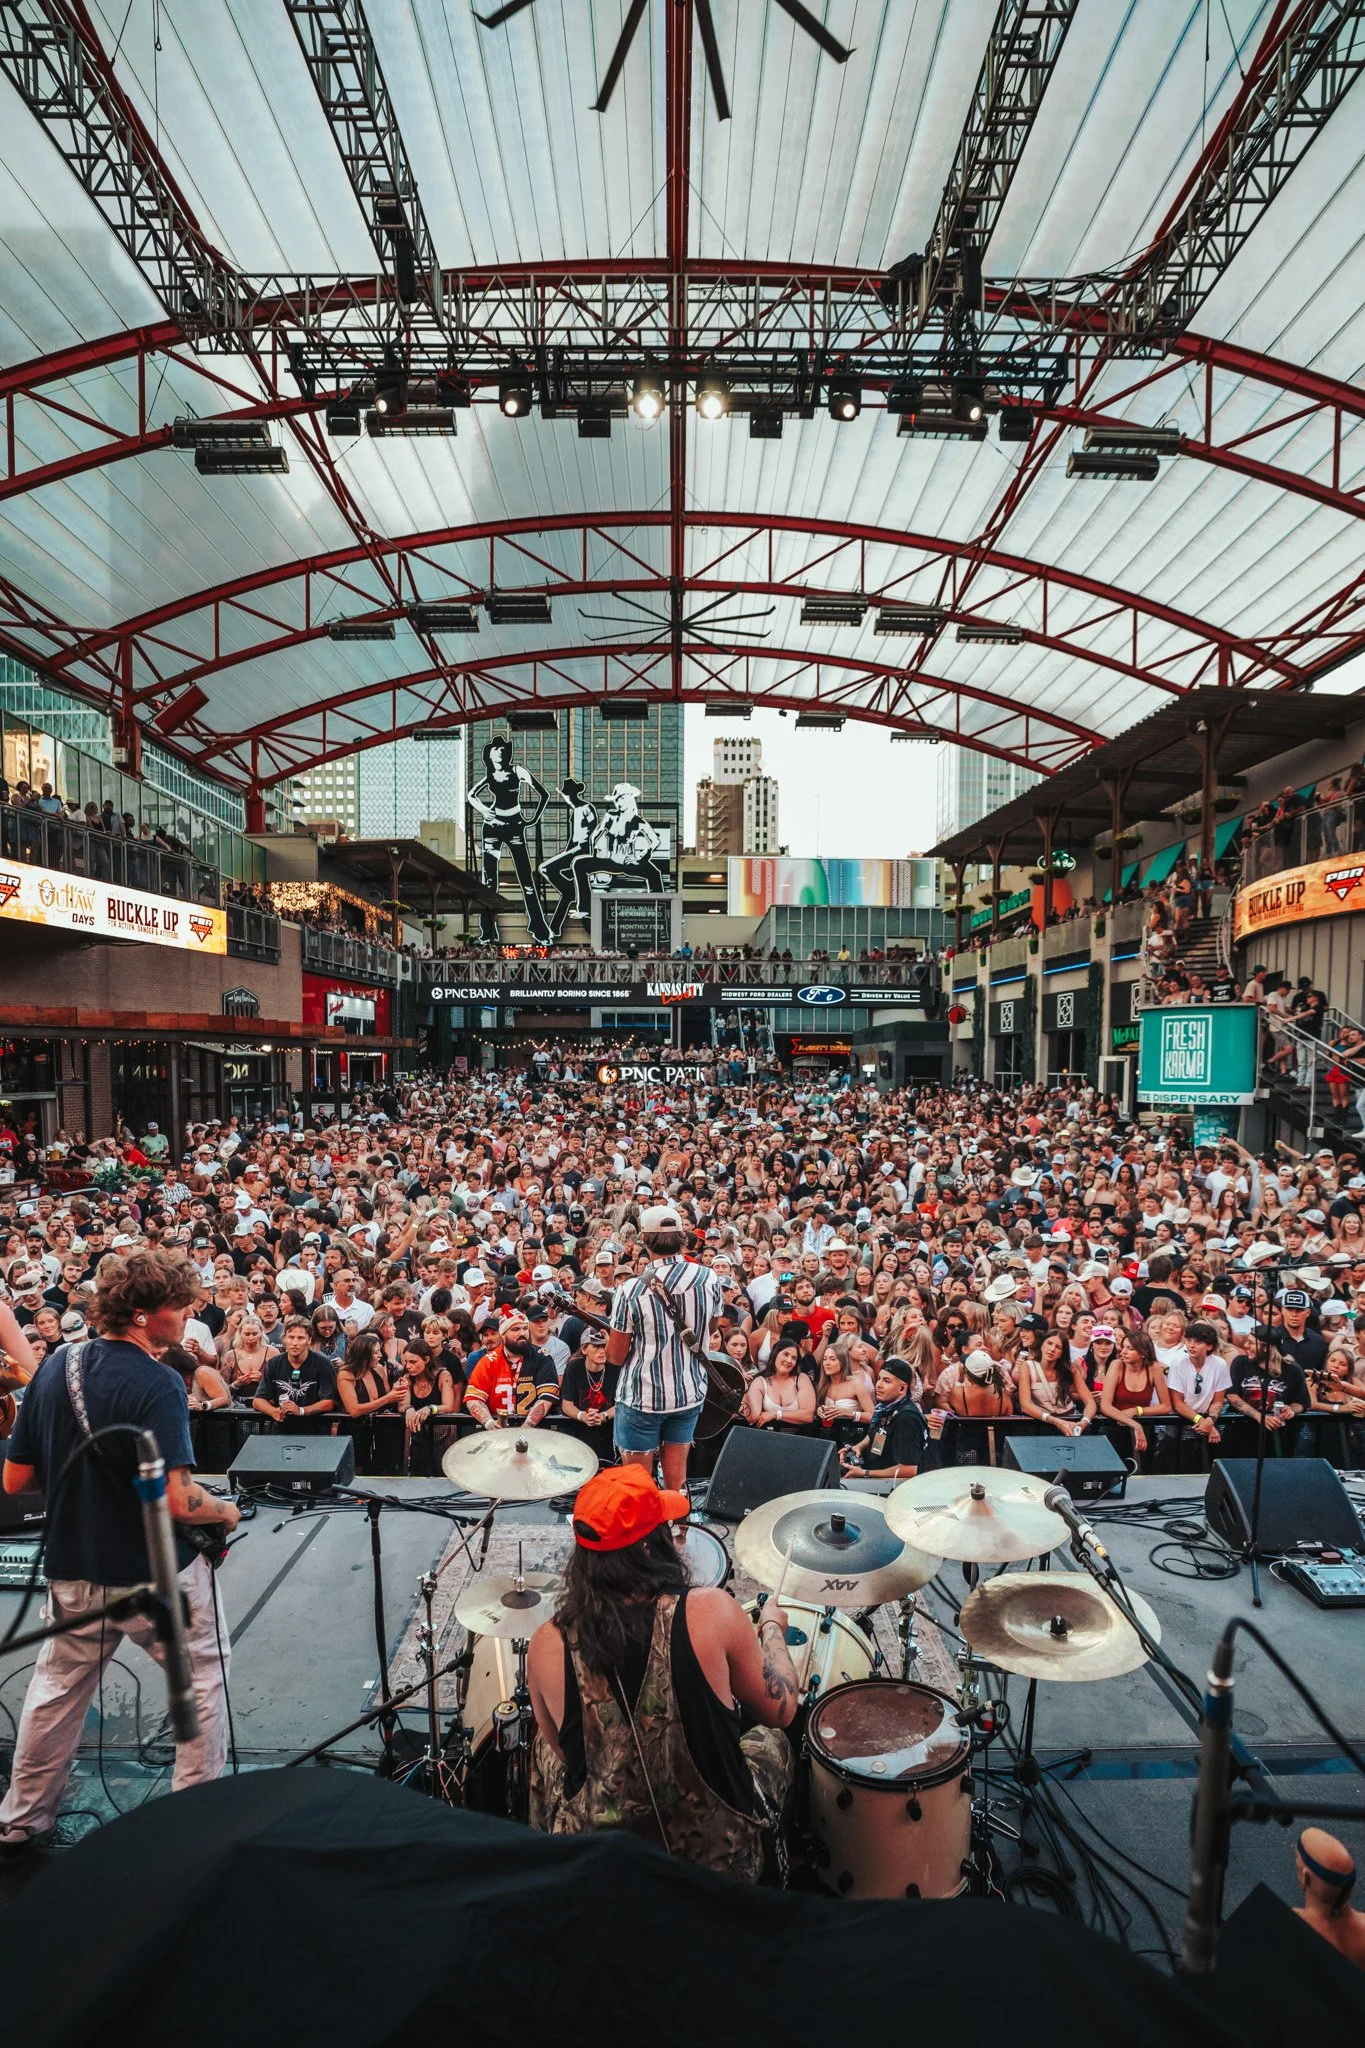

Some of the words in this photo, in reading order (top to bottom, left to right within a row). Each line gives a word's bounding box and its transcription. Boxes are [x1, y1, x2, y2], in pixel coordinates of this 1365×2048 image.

[0, 874, 20, 888] BR
[1326, 867, 1364, 883] PBR
[1286, 881, 1306, 906] UP
[72, 912, 95, 926] DAYS
[107, 897, 159, 928] BUCKLE
[163, 909, 179, 931] UP
[190, 915, 213, 927] PBR
[509, 989, 556, 998] BRILLIANTLY
[557, 989, 588, 998] BORING
[588, 990, 612, 998] SINCE
[646, 982, 682, 997] KANSAS
[1165, 1021, 1206, 1050] FRESH
[1164, 1050, 1205, 1079] KARMA
[619, 1066, 661, 1082] PNC
[1153, 1093, 1241, 1103] DISPENSARY
[819, 1578, 860, 1593] AAX
